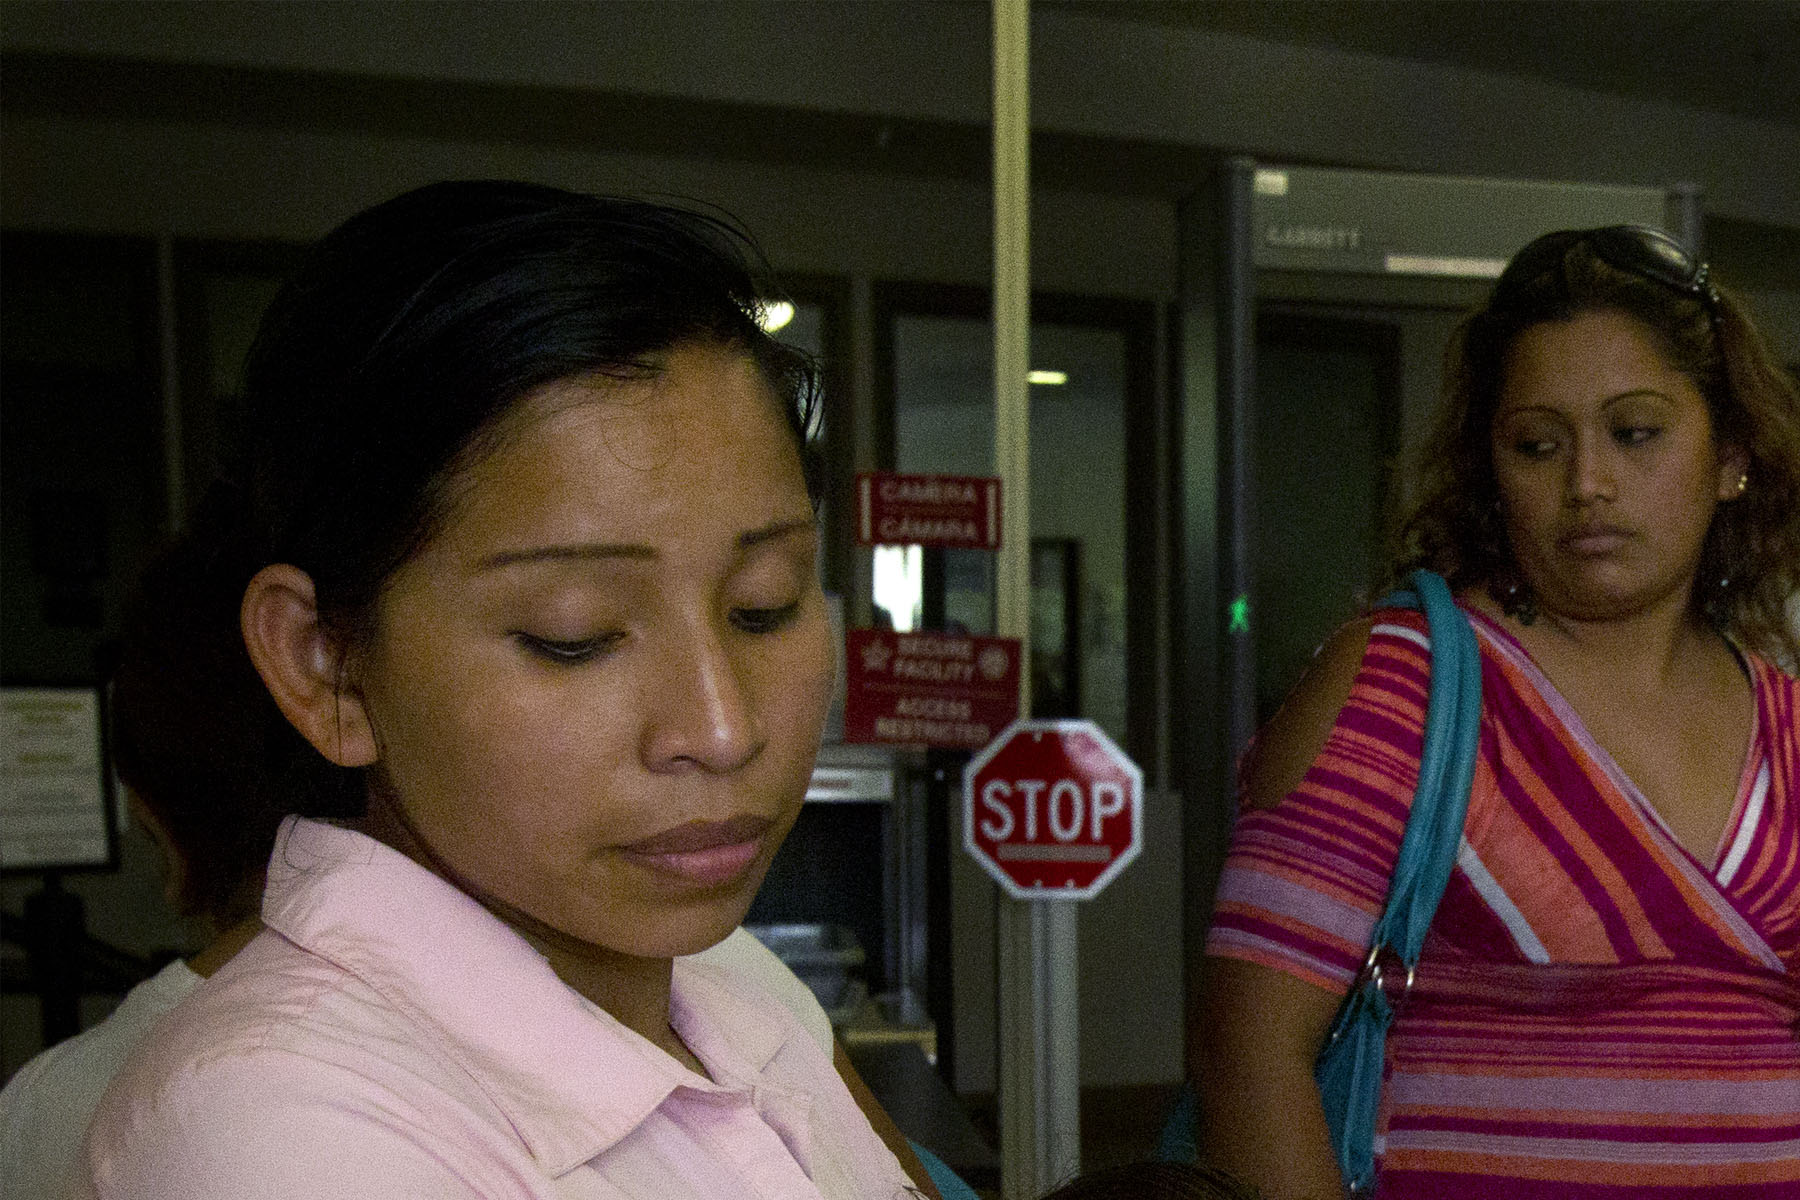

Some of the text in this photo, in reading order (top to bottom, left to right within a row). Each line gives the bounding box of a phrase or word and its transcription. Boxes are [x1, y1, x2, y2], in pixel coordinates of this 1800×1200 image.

[893, 657, 975, 683] FACILITY
[895, 697, 972, 721] ACCESS
[875, 716, 990, 743] RESTRICTED
[979, 778, 1126, 842] STOP
